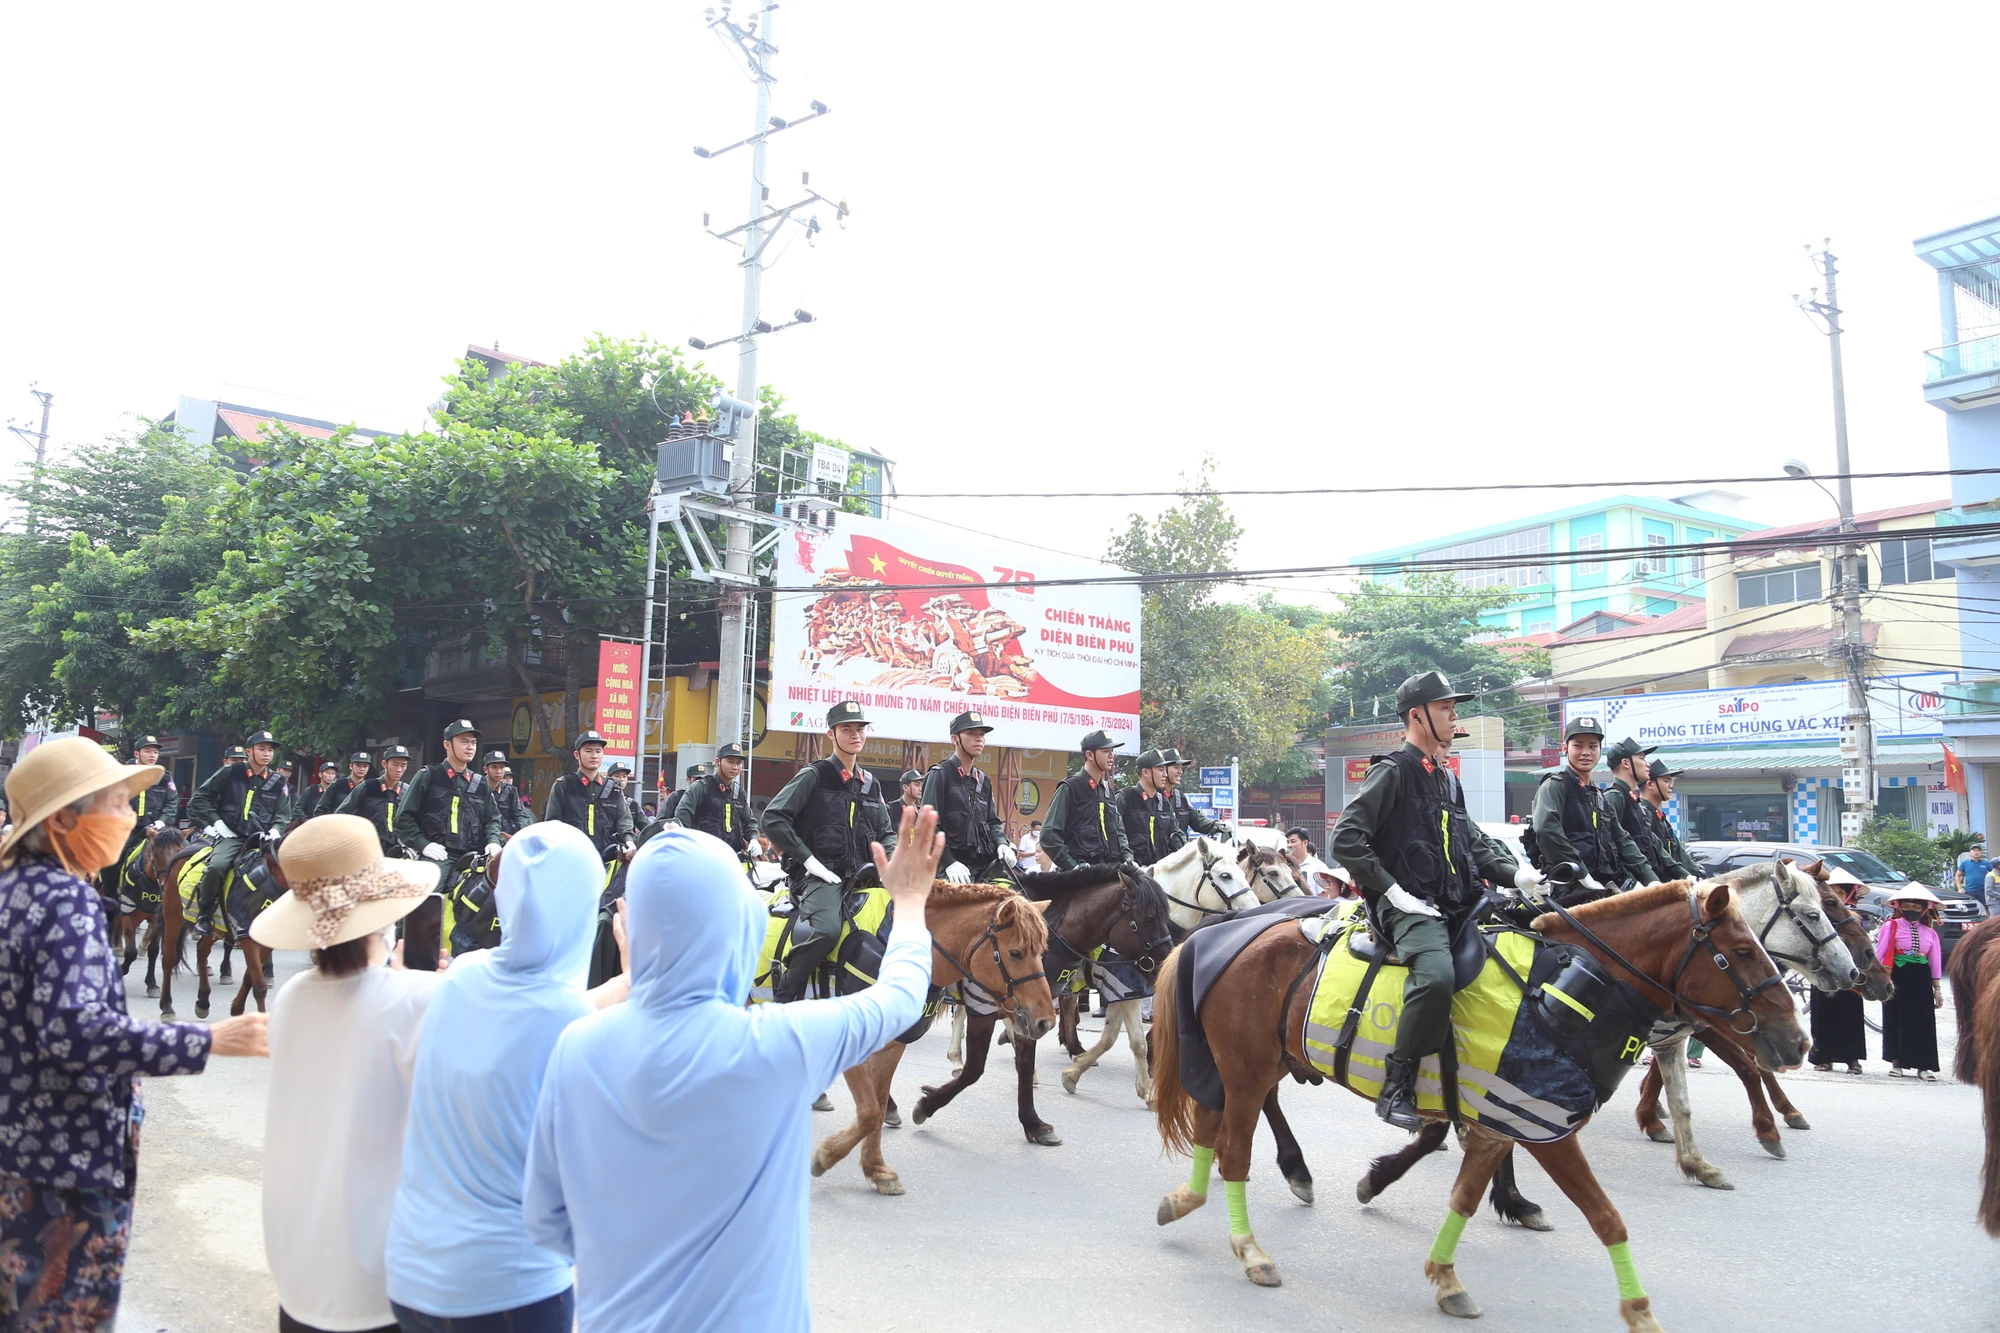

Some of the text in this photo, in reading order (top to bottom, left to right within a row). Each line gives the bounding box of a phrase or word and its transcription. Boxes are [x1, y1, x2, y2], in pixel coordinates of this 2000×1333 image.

[817, 459, 830, 470] TBA
[898, 556, 974, 582] QUYẾT CHIẾN QUYẾT THẮNG
[1044, 607, 1131, 634] CHIẾN THẮNG
[1040, 628, 1134, 654] ĐIỆN BIÊN PHỦ
[612, 662, 628, 674] NƯỚC
[605, 677, 621, 690] CỘNG
[609, 692, 628, 706] XÃ HỘI
[602, 706, 632, 720] CHỦ NGHĨA
[788, 685, 819, 704] NHIỆT
[822, 688, 842, 706] LIỆT
[845, 689, 871, 706] CHÀO
[874, 692, 904, 710] MỪNG
[906, 696, 917, 710] 70
[920, 696, 941, 713] NĂM
[972, 699, 999, 718] THẮNG
[1001, 704, 1020, 722] ĐIỆN
[1022, 706, 1041, 721] BIÊN
[1042, 707, 1058, 724] PHỦ
[1060, 712, 1094, 726] (7/5/1954
[1100, 716, 1133, 732] 7/5/2024)
[603, 722, 630, 735] VIỆT NAM
[1640, 723, 1686, 738] PHÒNG
[1690, 720, 1725, 735] TIÊM
[1730, 717, 1782, 733] CHỦNG
[1787, 714, 1817, 730] VẮC
[616, 738, 630, 750] NĂM
[1932, 802, 1939, 814] AN
